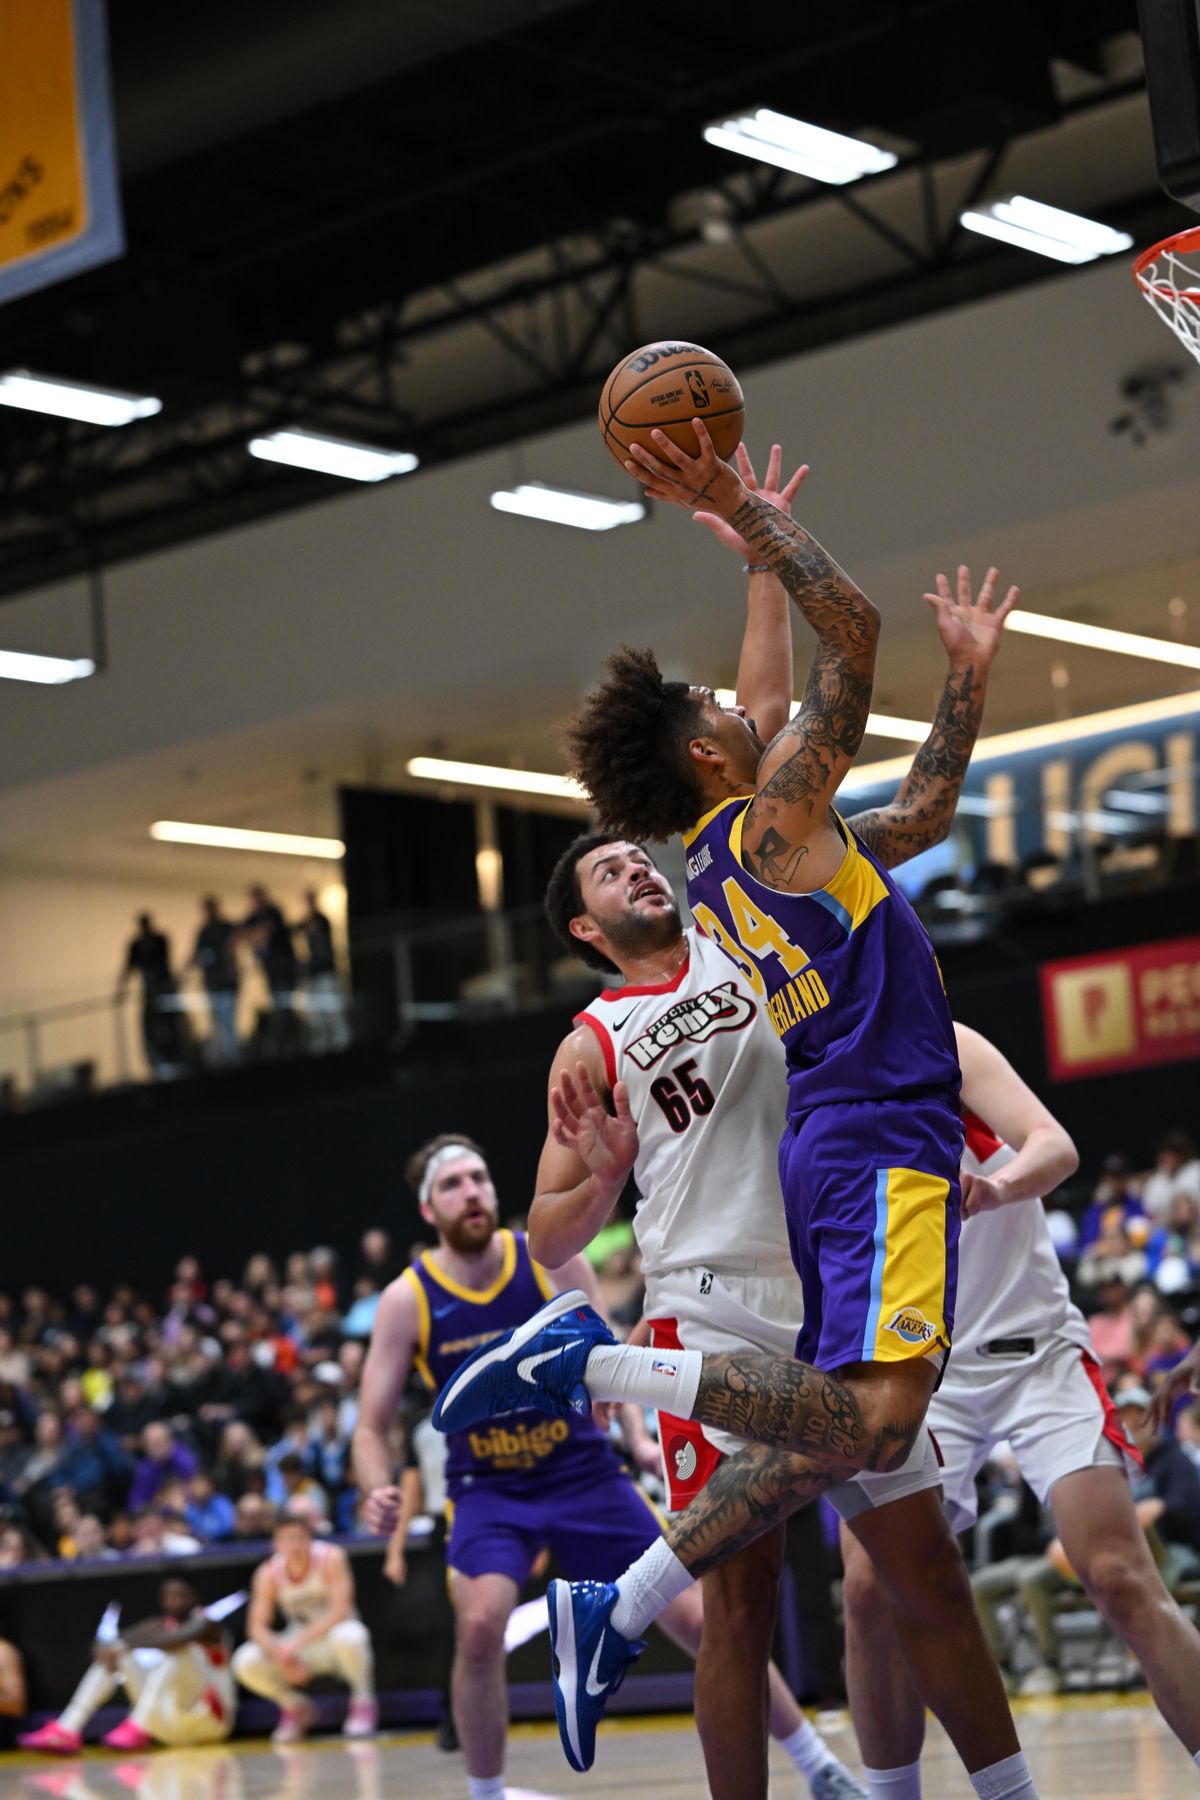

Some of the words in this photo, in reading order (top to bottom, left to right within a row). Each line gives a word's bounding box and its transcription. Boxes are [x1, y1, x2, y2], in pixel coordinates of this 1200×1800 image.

[691, 876, 811, 997] 34
[649, 1015, 669, 1036] RIP
[669, 1001, 696, 1017] CITY
[650, 1057, 717, 1134] 65
[468, 1419, 569, 1458] bibigo
